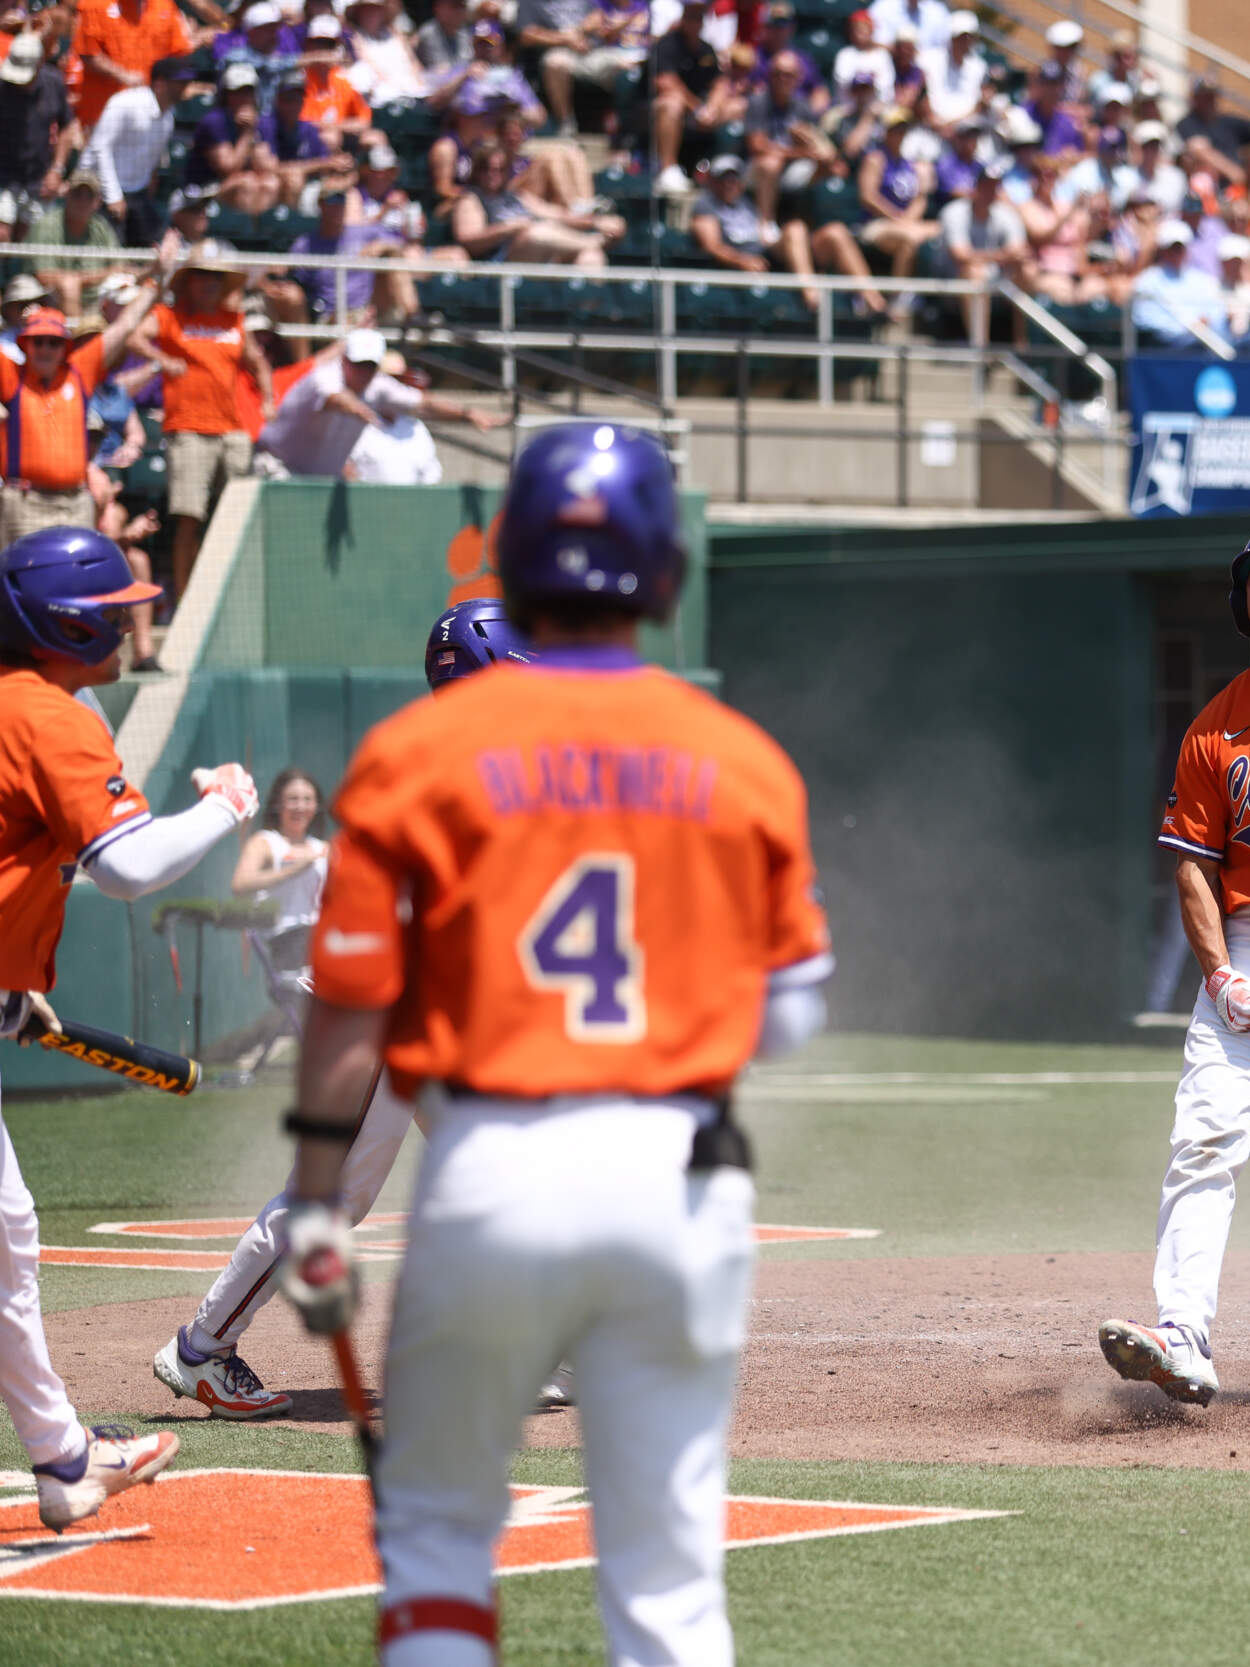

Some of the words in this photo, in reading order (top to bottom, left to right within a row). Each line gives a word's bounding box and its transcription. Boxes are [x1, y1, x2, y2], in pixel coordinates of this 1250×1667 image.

[442, 631, 449, 641] 2
[516, 850, 647, 1044] 4
[37, 1032, 180, 1091] EASTON
